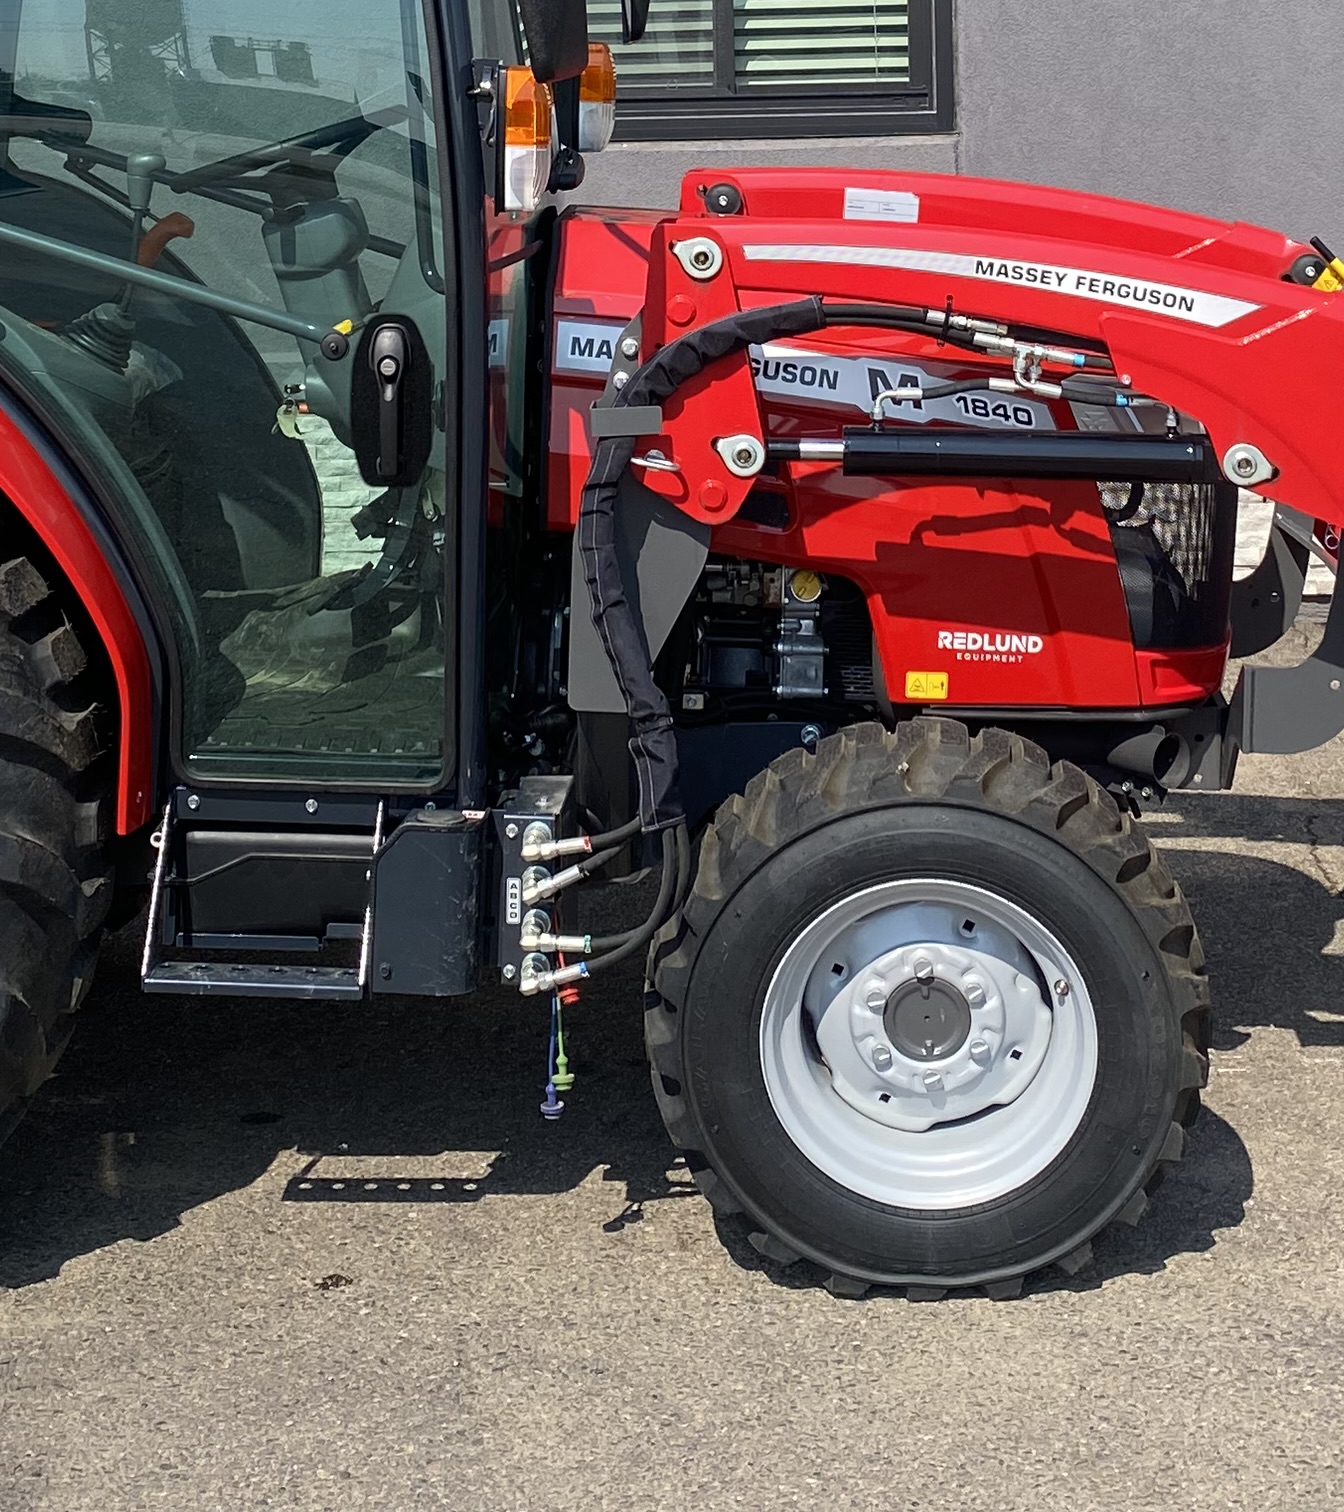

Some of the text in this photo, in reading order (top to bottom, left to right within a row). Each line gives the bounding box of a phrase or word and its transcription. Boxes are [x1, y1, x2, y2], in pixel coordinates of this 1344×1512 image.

[975, 260, 1195, 312] MASSEY FERGUSON
[751, 358, 839, 390] GUSON
[956, 395, 1033, 427] 1840
[937, 630, 1043, 653] REDLUND
[956, 652, 1024, 663] EQUIPMENT
